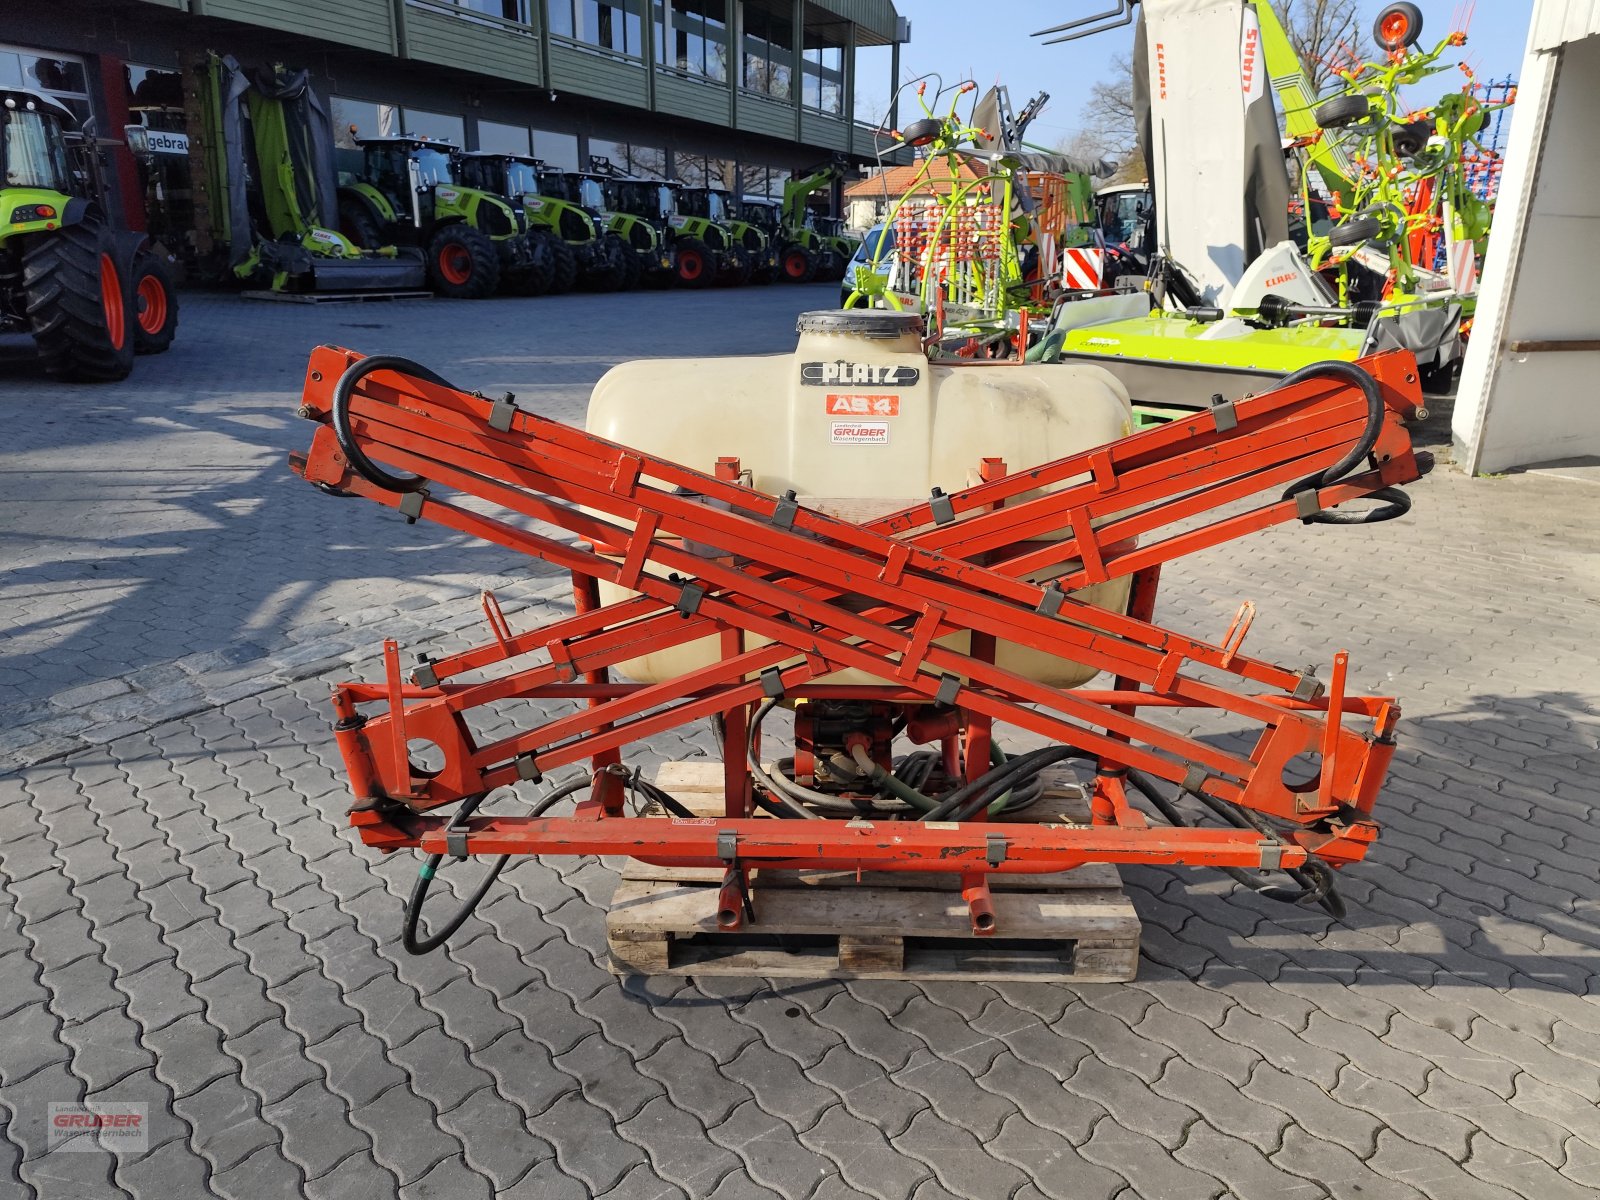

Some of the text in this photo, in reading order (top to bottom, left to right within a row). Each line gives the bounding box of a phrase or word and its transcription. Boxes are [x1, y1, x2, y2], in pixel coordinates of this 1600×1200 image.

[1242, 28, 1258, 93] CLAAS
[1156, 43, 1167, 100] CLAAS
[1265, 272, 1297, 288] CLAAS
[821, 362, 899, 383] PLATZ
[833, 428, 886, 437] GRUBER
